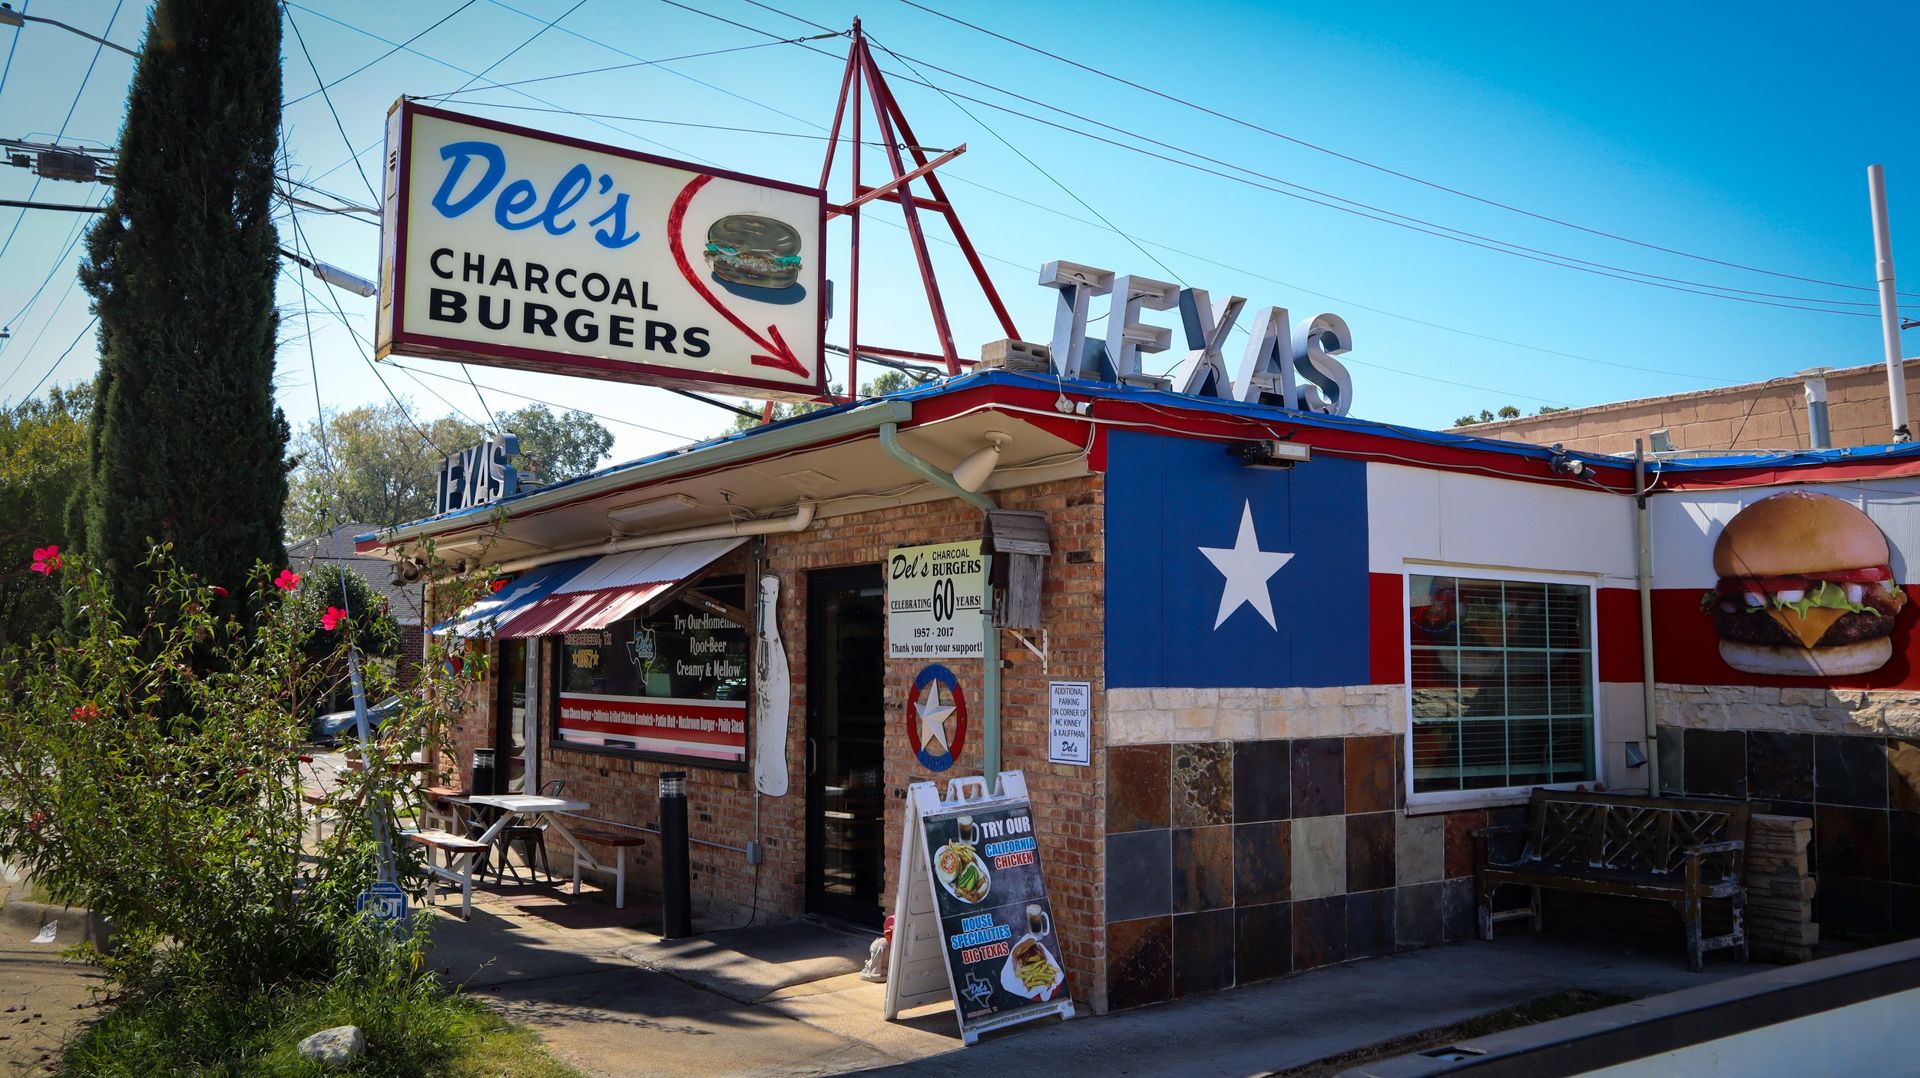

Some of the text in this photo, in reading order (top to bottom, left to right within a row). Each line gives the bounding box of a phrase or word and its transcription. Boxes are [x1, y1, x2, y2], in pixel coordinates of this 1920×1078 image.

[432, 141, 640, 249] Del's
[429, 247, 659, 311] CHARCOAL
[428, 287, 711, 358] BURGERS
[1038, 259, 1353, 417] TEXAS
[433, 433, 518, 515] TEXAS
[892, 548, 970, 580] Del's CHARCOAL
[932, 559, 981, 576] BURGERS
[891, 578, 981, 622] CELEBRATING 60 YEARS!
[674, 614, 686, 635] Try
[914, 628, 930, 638] 1957
[937, 627, 954, 637] 2017
[891, 642, 983, 655] Thank you for your support!
[676, 659, 741, 681] Creamy & Mellow
[1054, 687, 1083, 696] ADDITIONAL
[1059, 697, 1080, 706] PARKING
[1052, 708, 1087, 717] ON CORNER OF
[1059, 730, 1085, 738] KAUFFMAN
[1062, 740, 1077, 752] Del's
[981, 816, 1031, 839] TRY OUR
[984, 837, 1036, 858] CALIFORNIA
[994, 852, 1034, 870] CHICKEN
[962, 913, 993, 932] HOUSE
[951, 924, 1012, 950] SPECIALITIES
[962, 942, 1010, 965] BIG TEXAS
